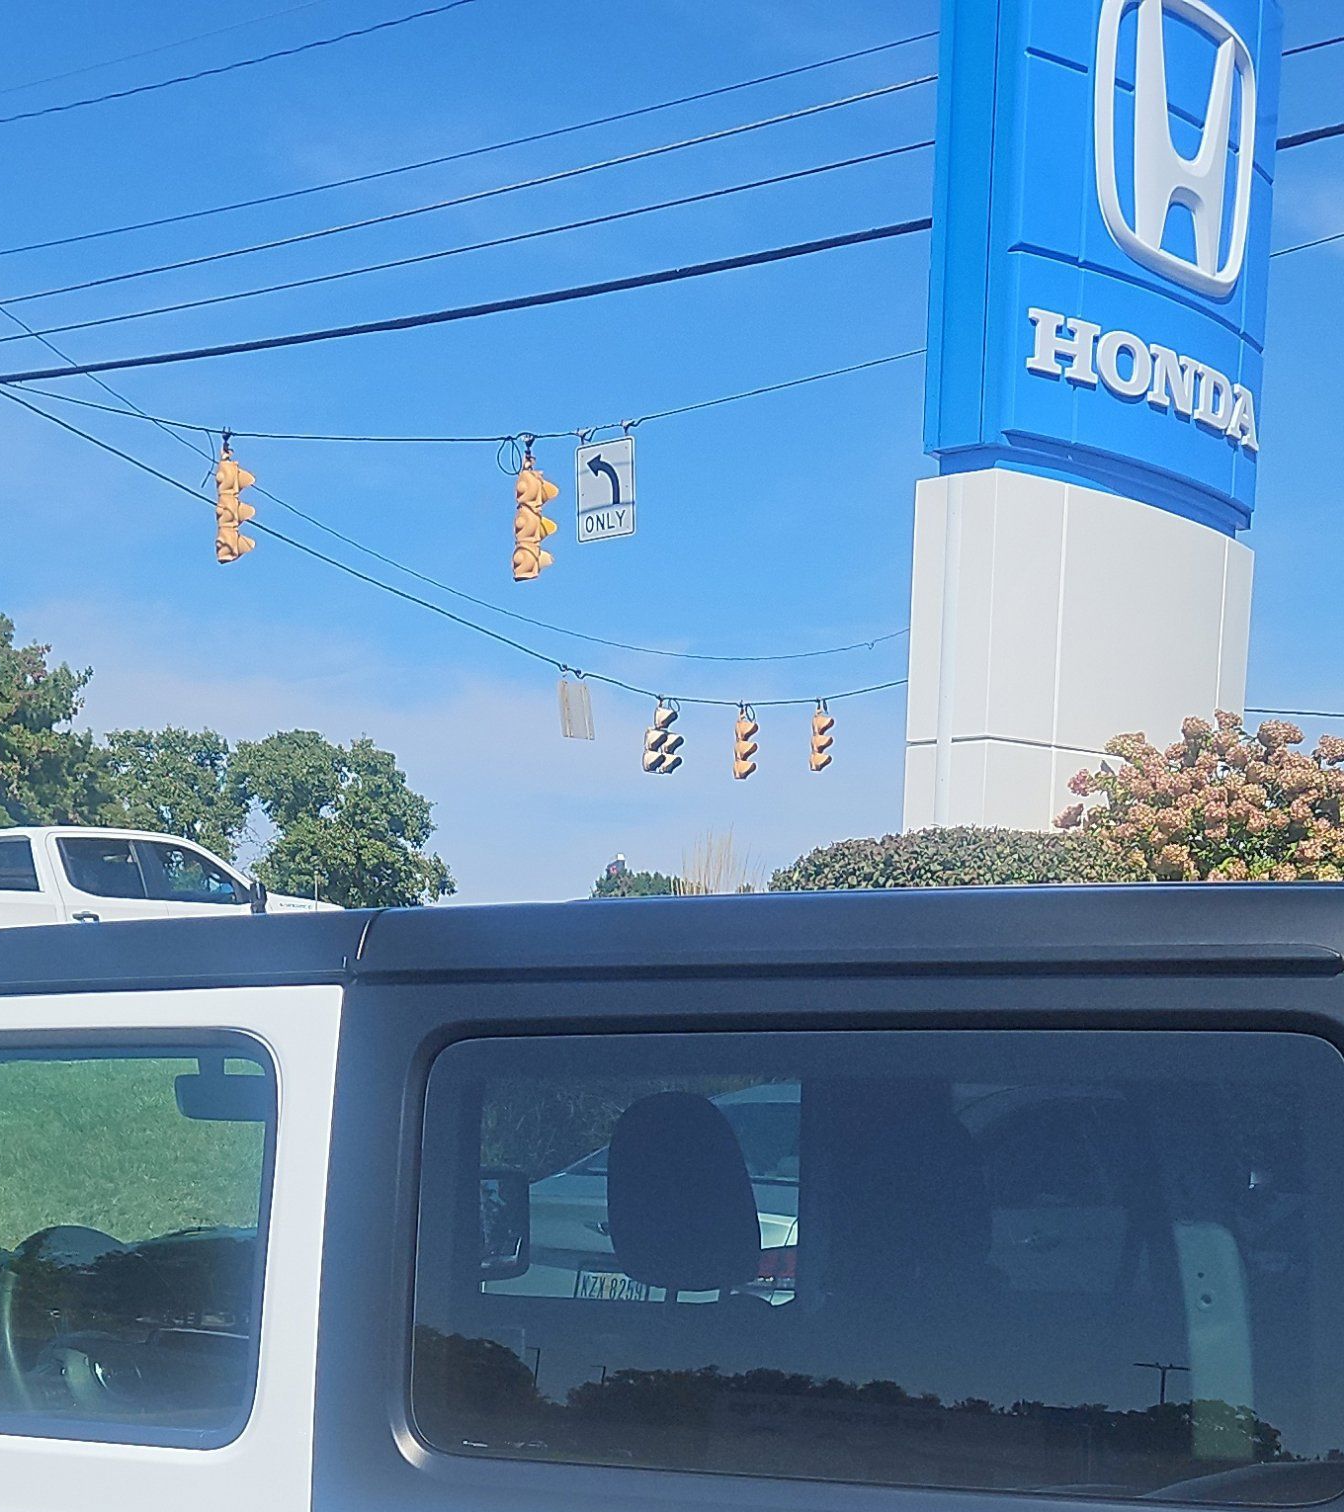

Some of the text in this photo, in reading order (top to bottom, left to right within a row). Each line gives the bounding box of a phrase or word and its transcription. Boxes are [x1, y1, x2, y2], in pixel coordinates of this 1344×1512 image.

[1025, 307, 1259, 453] HONDA
[585, 509, 626, 534] ONLY
[580, 1274, 606, 1299] KZX
